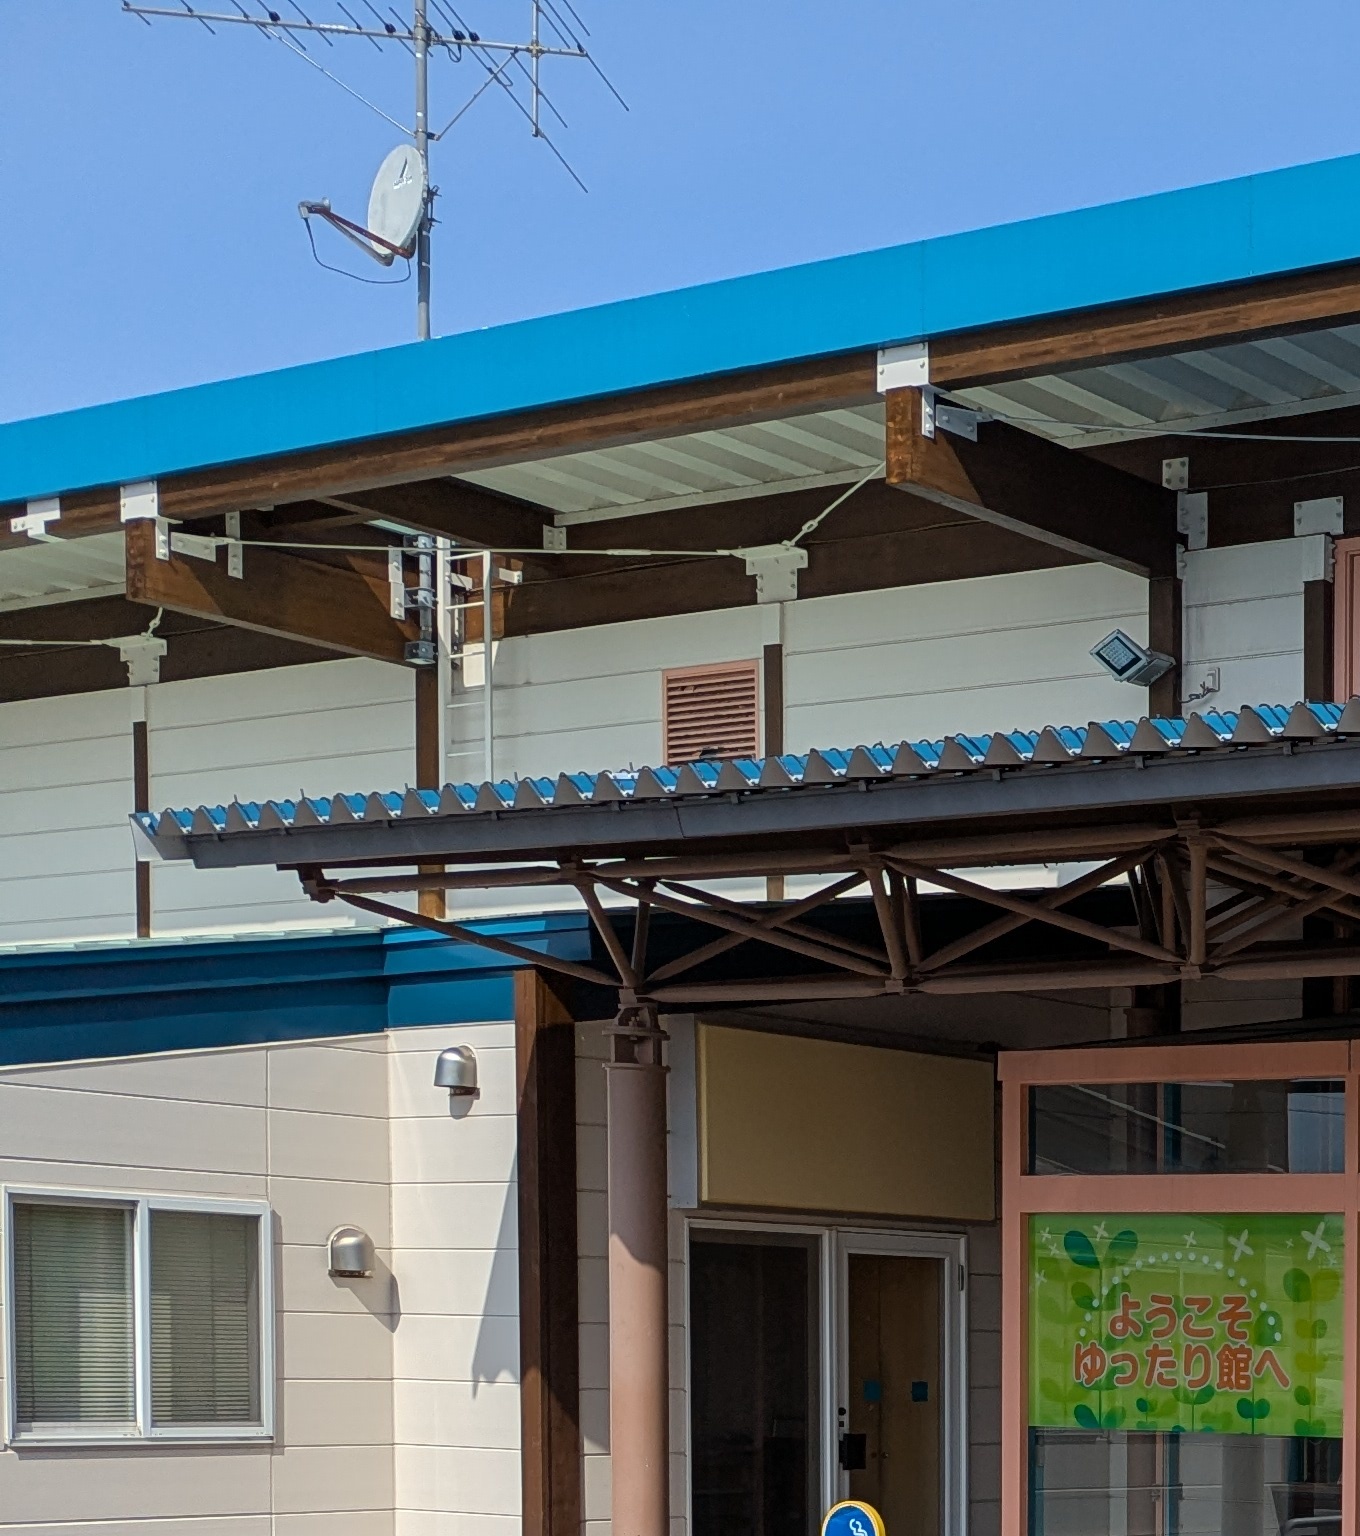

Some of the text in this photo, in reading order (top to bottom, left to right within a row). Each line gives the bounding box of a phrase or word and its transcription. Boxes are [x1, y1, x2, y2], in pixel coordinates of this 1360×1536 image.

[1109, 1292, 1253, 1341] ようこそ
[1074, 1341, 1291, 1391] ゆったり館へ
